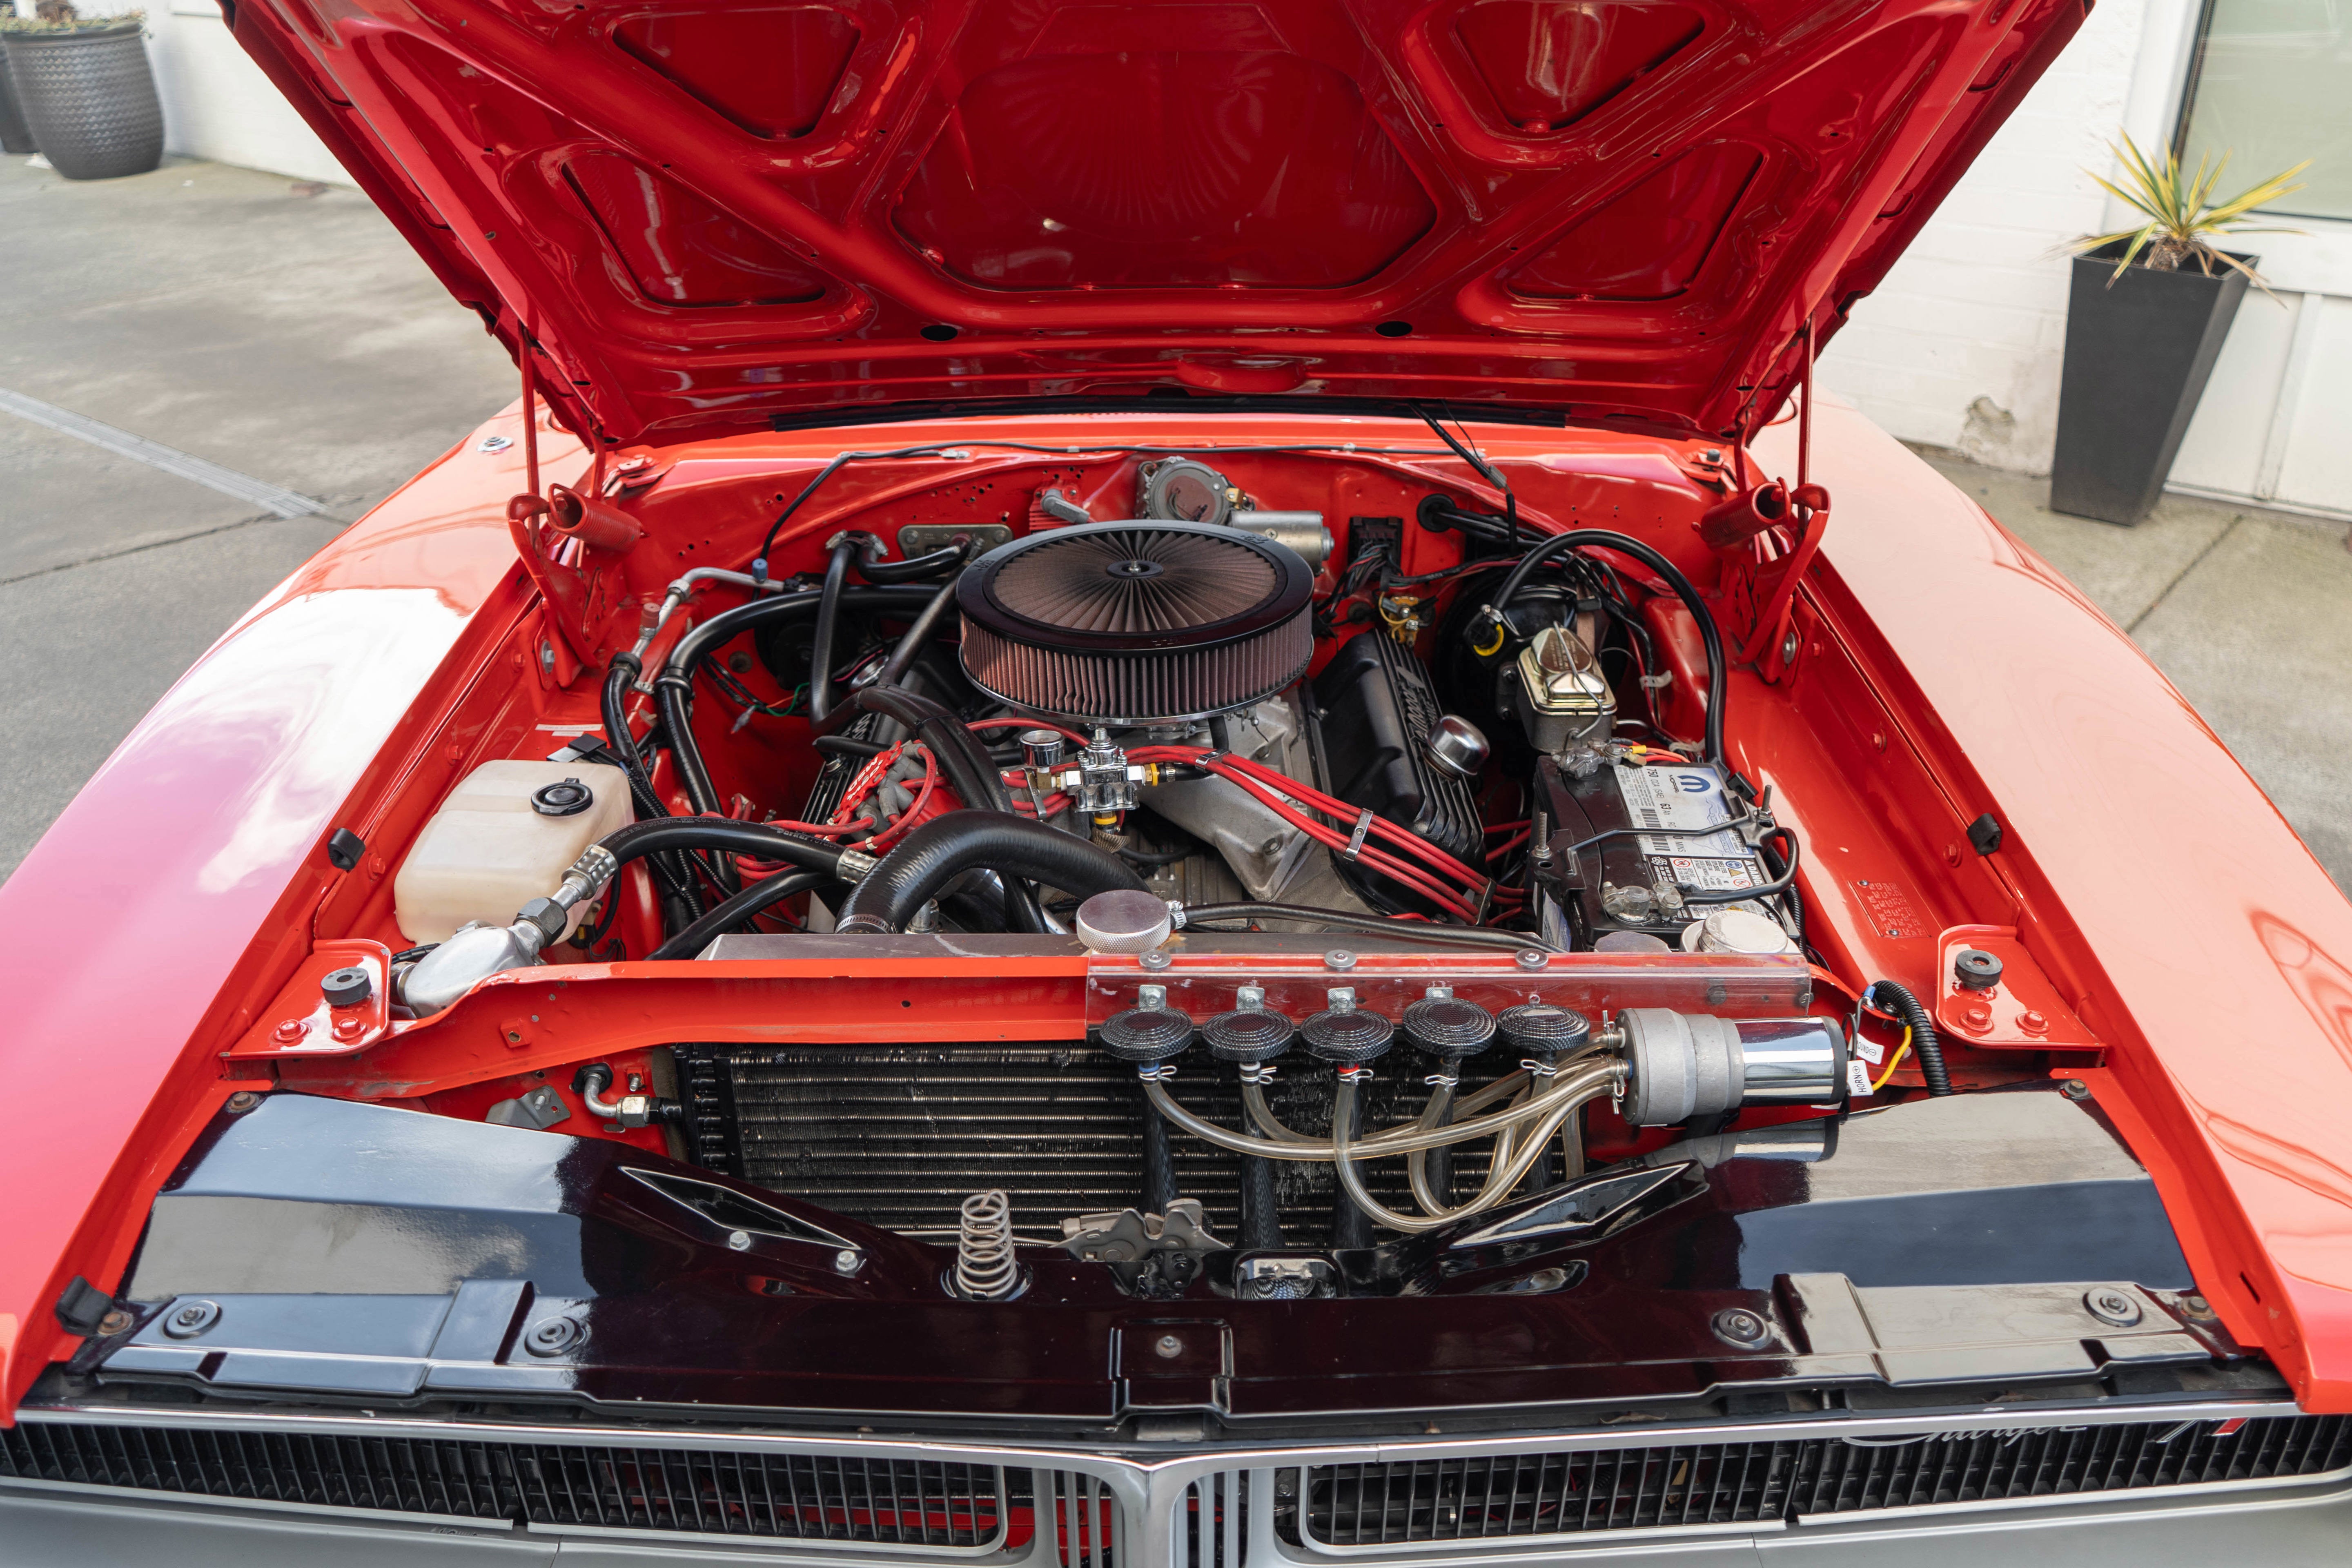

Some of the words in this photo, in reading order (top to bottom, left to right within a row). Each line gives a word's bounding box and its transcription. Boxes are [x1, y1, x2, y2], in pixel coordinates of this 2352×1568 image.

[848, 756, 878, 792] MSD
[1646, 768, 1659, 777] 750
[1746, 866, 1765, 886] DANG
[1853, 1074, 1867, 1093] HORN
